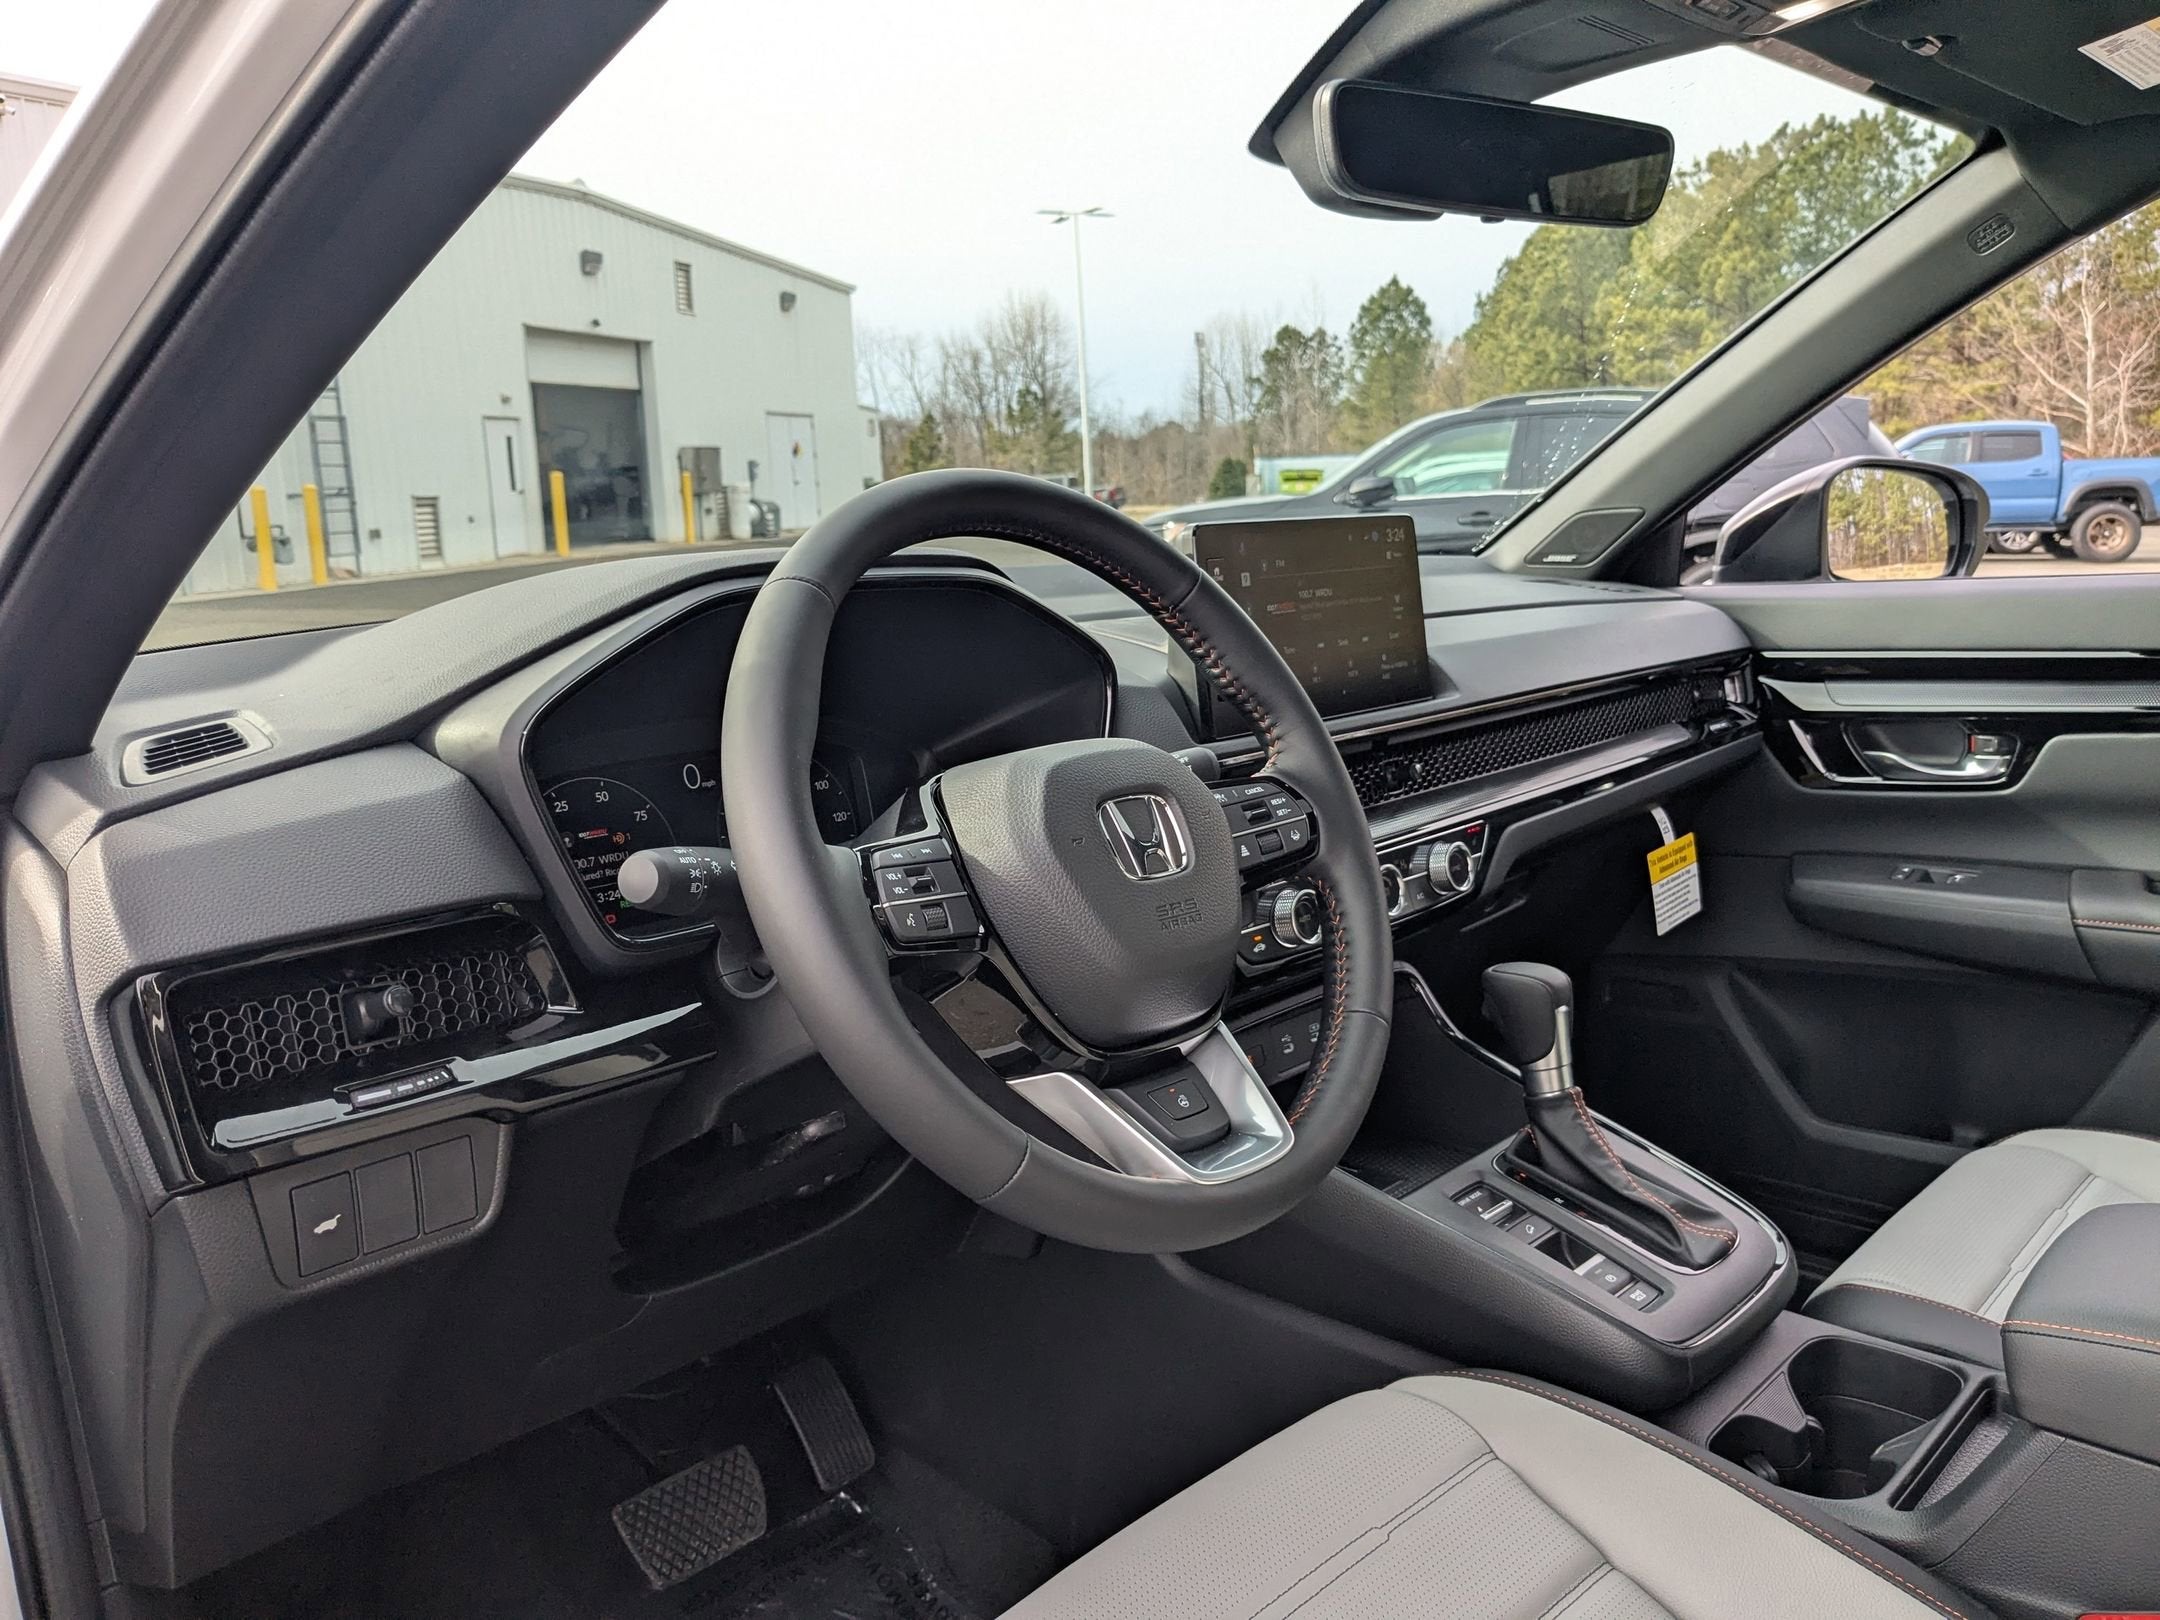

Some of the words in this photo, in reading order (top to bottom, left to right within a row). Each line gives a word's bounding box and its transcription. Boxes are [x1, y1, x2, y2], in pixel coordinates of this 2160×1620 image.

[683, 763, 701, 789] 0
[814, 780, 829, 791] 100
[595, 791, 609, 803] 50
[553, 801, 569, 813] 25
[633, 810, 648, 822] 75
[832, 811, 847, 822] 120
[597, 890, 620, 903] 3:24
